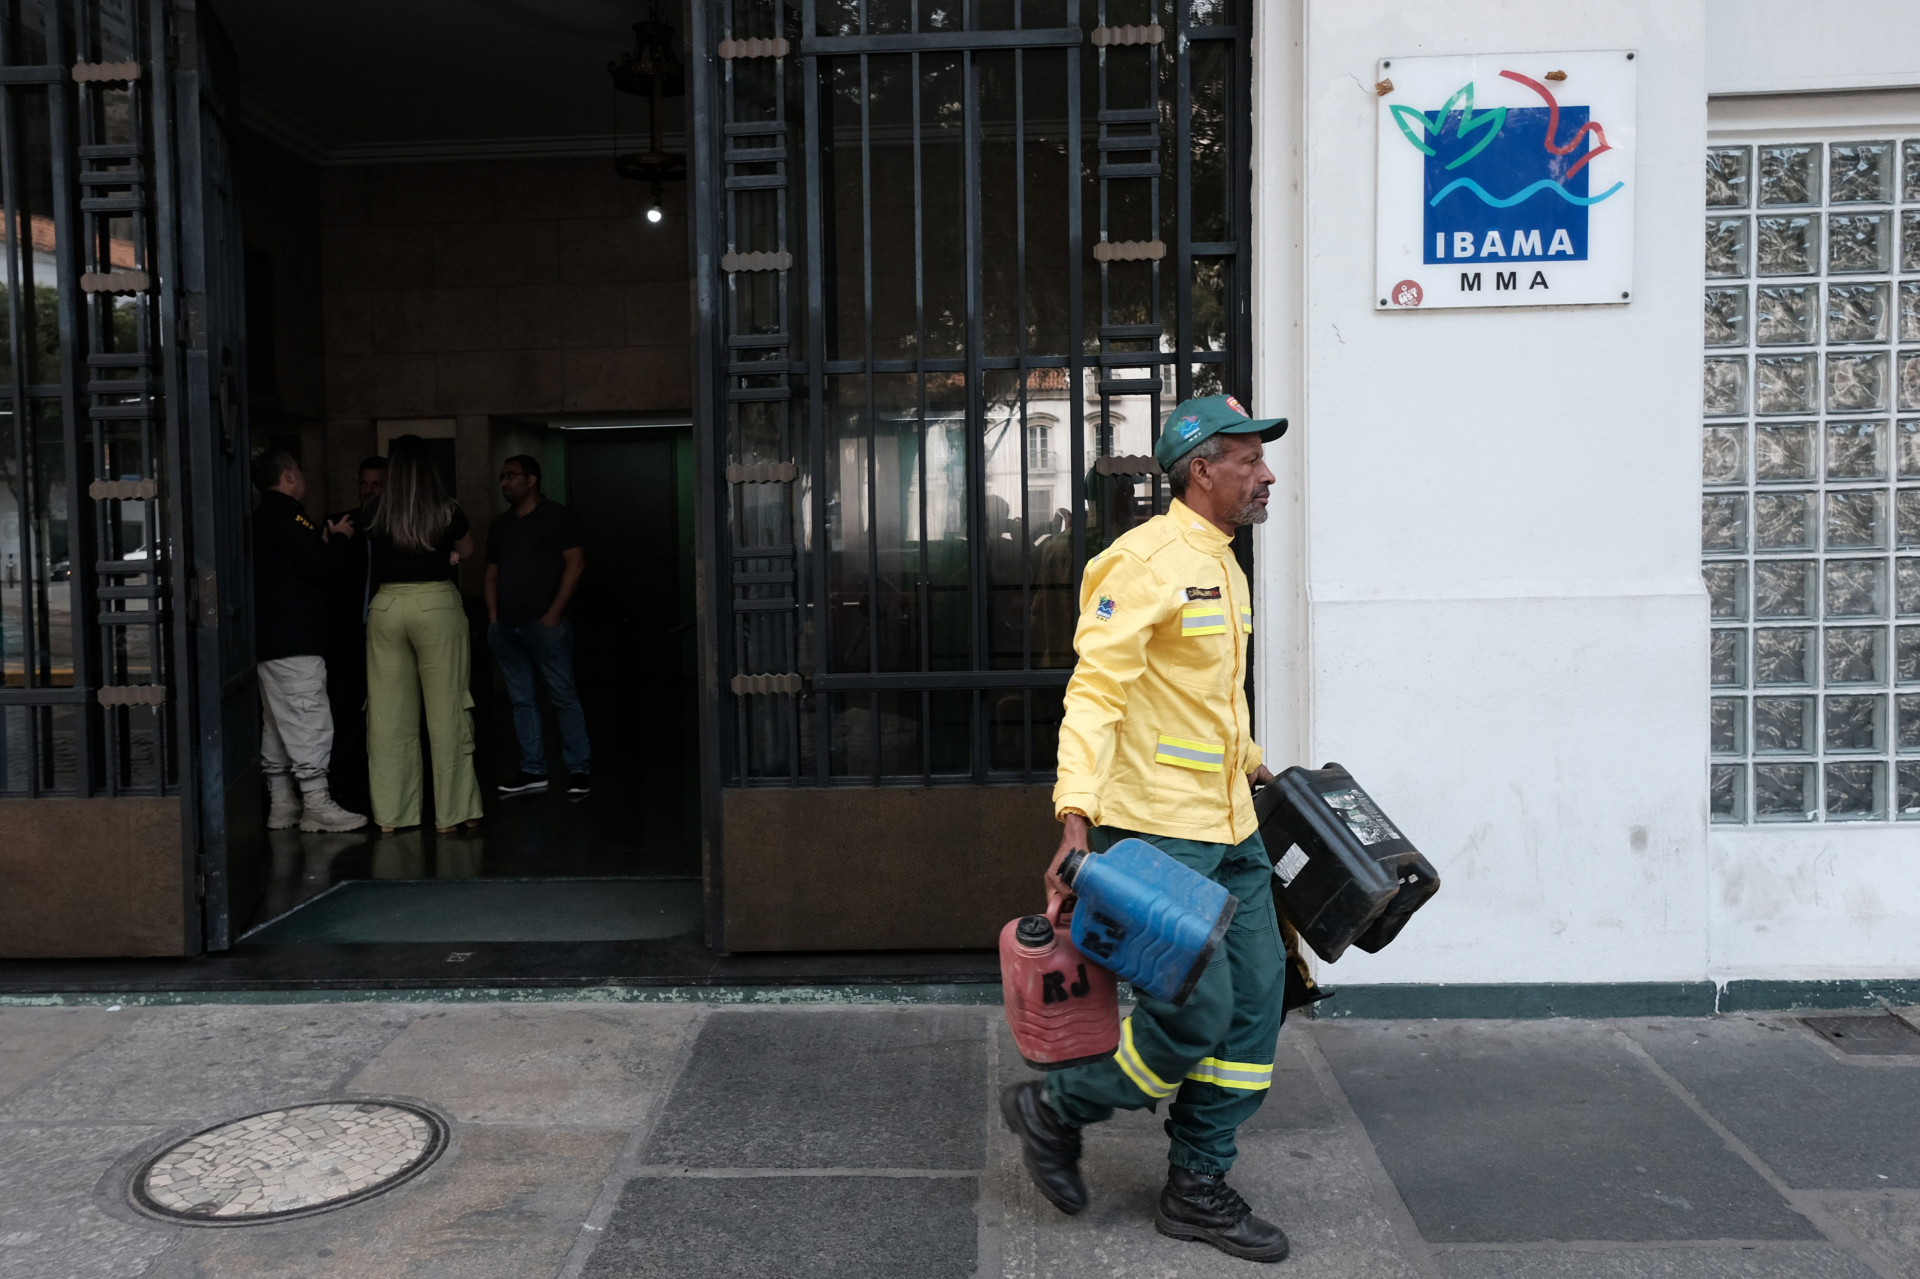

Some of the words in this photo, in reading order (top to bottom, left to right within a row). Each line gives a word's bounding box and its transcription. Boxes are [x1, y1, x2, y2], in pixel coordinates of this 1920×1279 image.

[1436, 228, 1574, 259] IBAMA
[1460, 270, 1549, 292] MMA
[1081, 910, 1127, 960] RJ
[1042, 963, 1091, 1005] RJ
